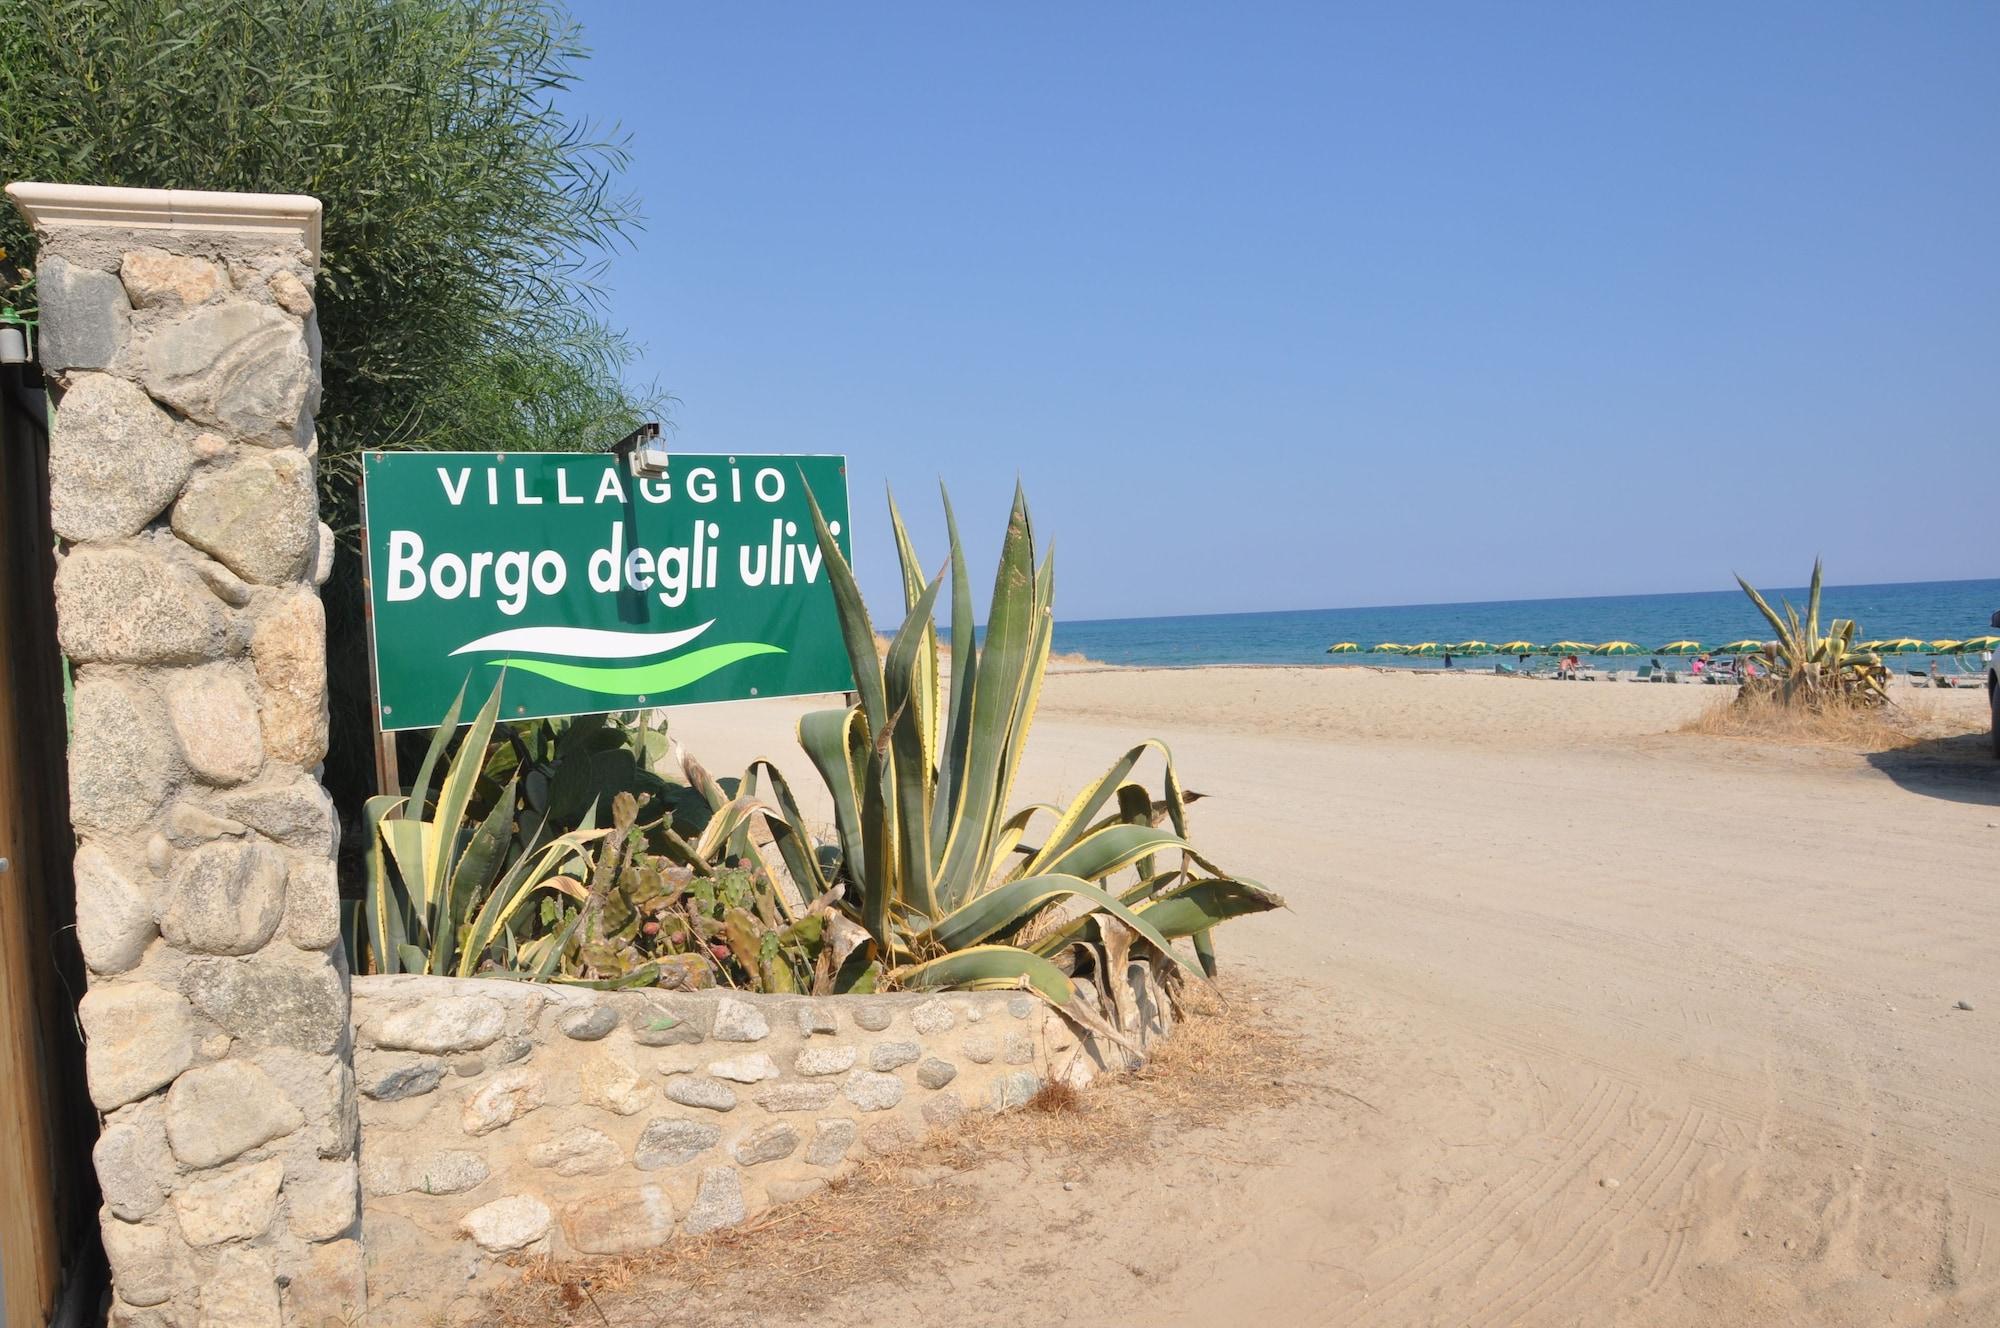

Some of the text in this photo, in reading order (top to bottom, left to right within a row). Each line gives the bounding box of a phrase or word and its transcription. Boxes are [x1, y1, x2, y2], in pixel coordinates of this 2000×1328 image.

[437, 467, 786, 504] VILLAGGIO
[386, 530, 567, 615] Borgo
[588, 520, 720, 607] degli
